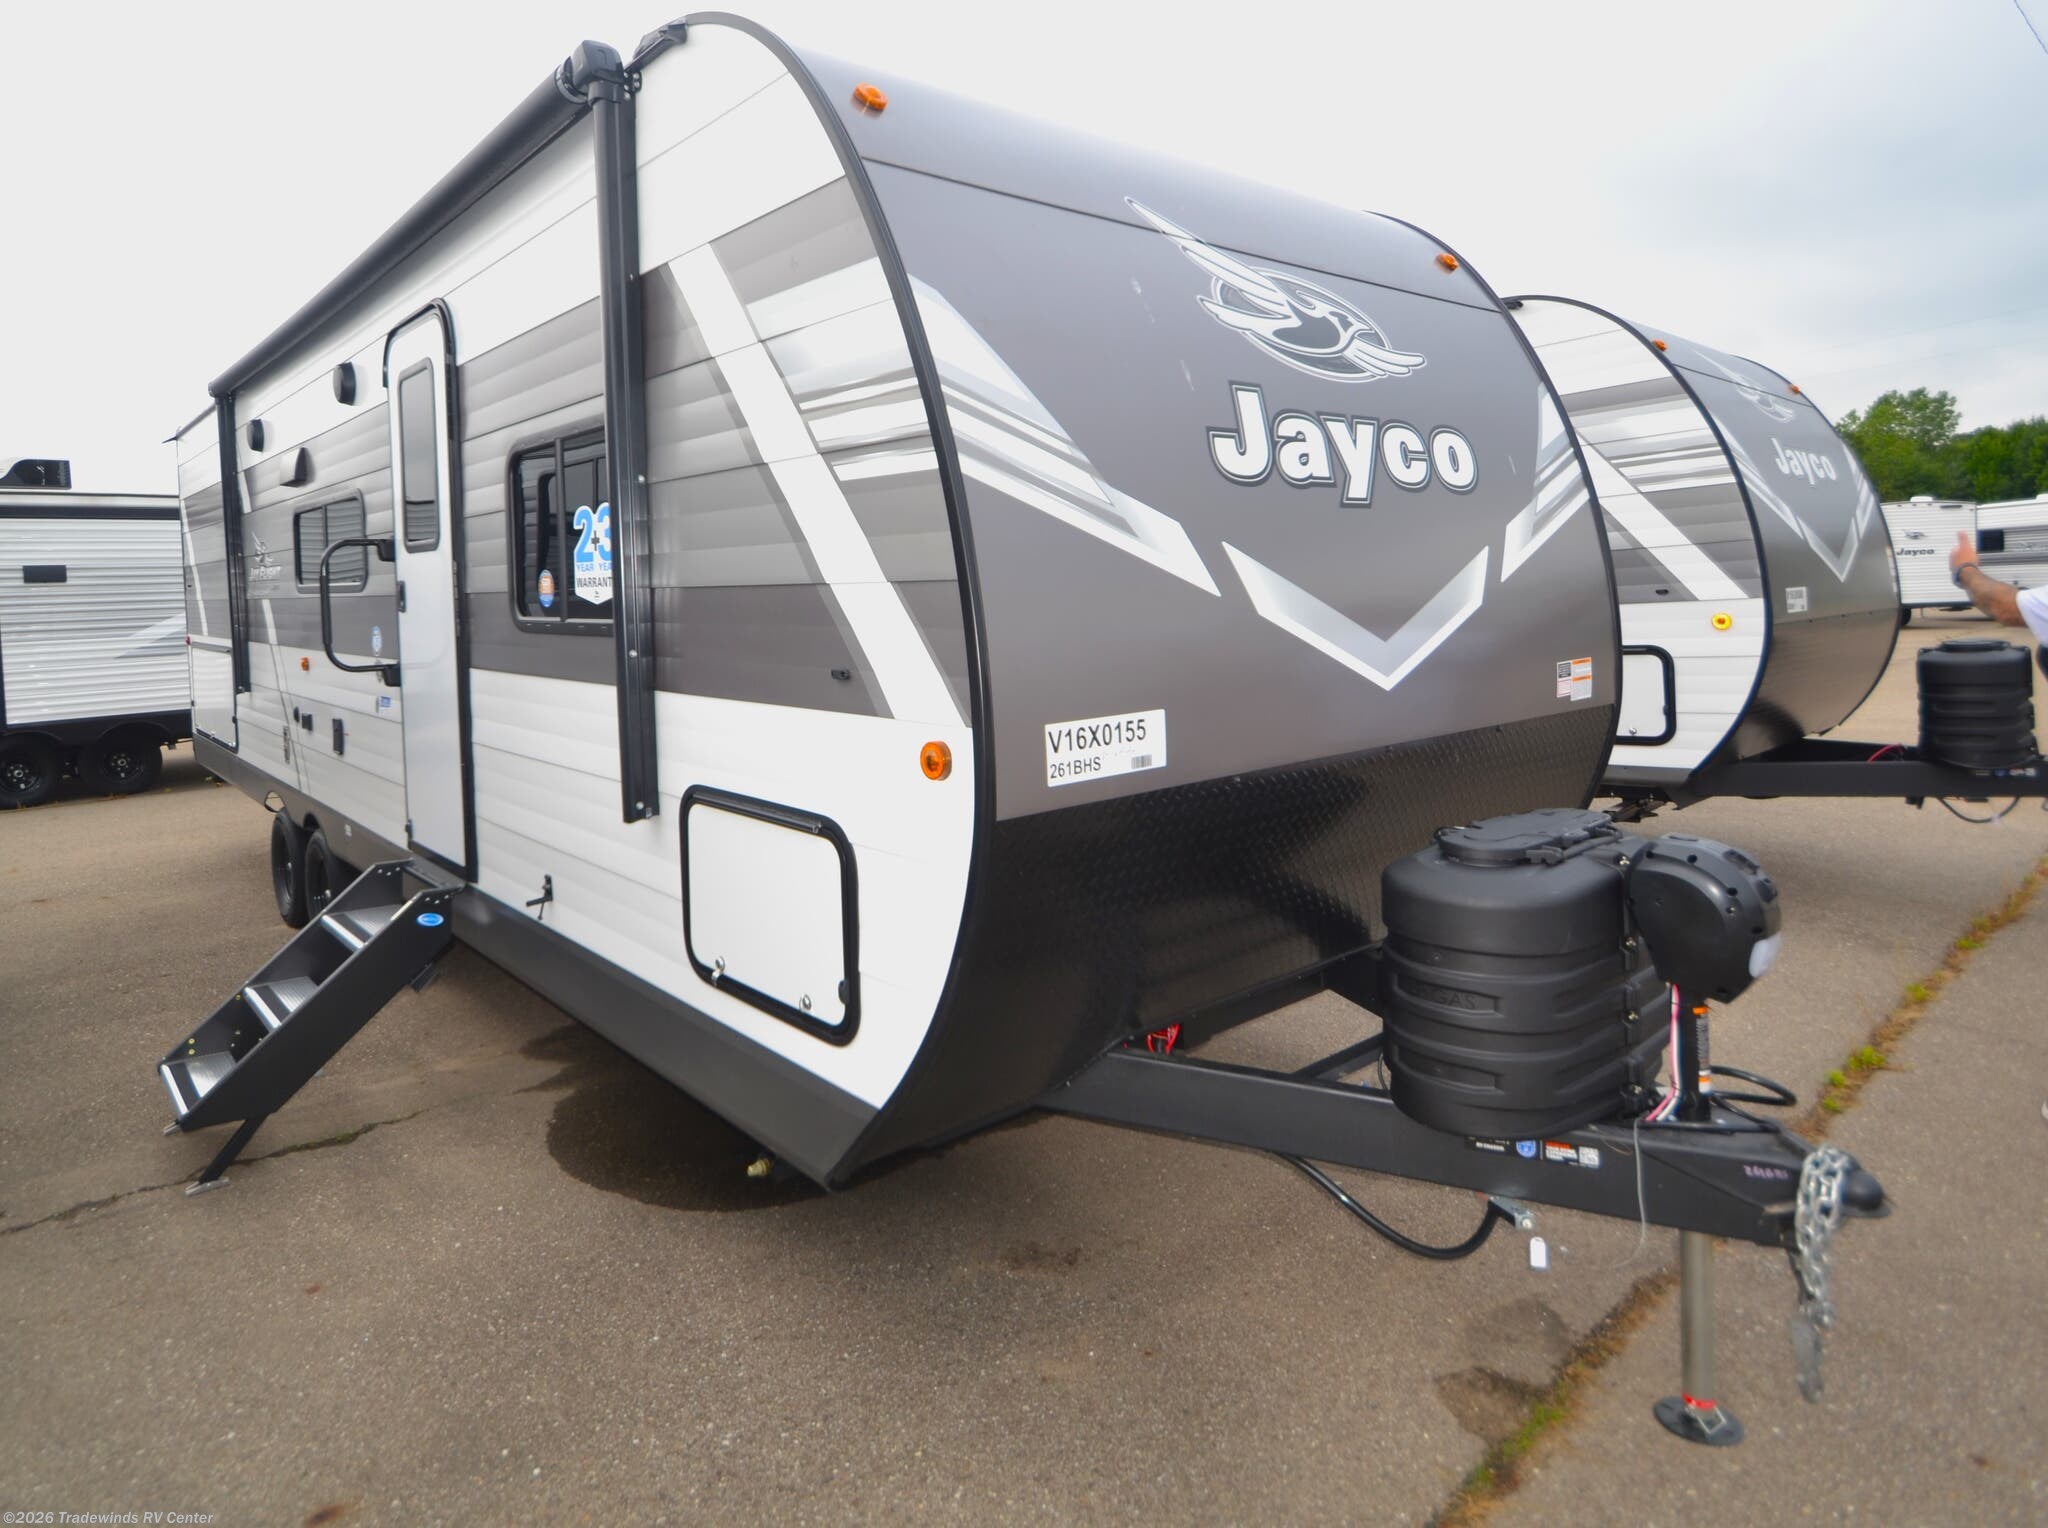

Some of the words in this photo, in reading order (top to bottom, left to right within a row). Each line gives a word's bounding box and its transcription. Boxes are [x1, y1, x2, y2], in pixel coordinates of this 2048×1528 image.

[1206, 381, 1479, 508] Jayco
[1771, 437, 1837, 485] Jayco
[1896, 548, 1935, 556] Jayco
[576, 563, 594, 571] YEAR
[599, 562, 613, 571] YEA
[576, 577, 613, 588] WARRANT
[1048, 719, 1146, 753] V16X0155
[1050, 757, 1101, 779] 261BHS
